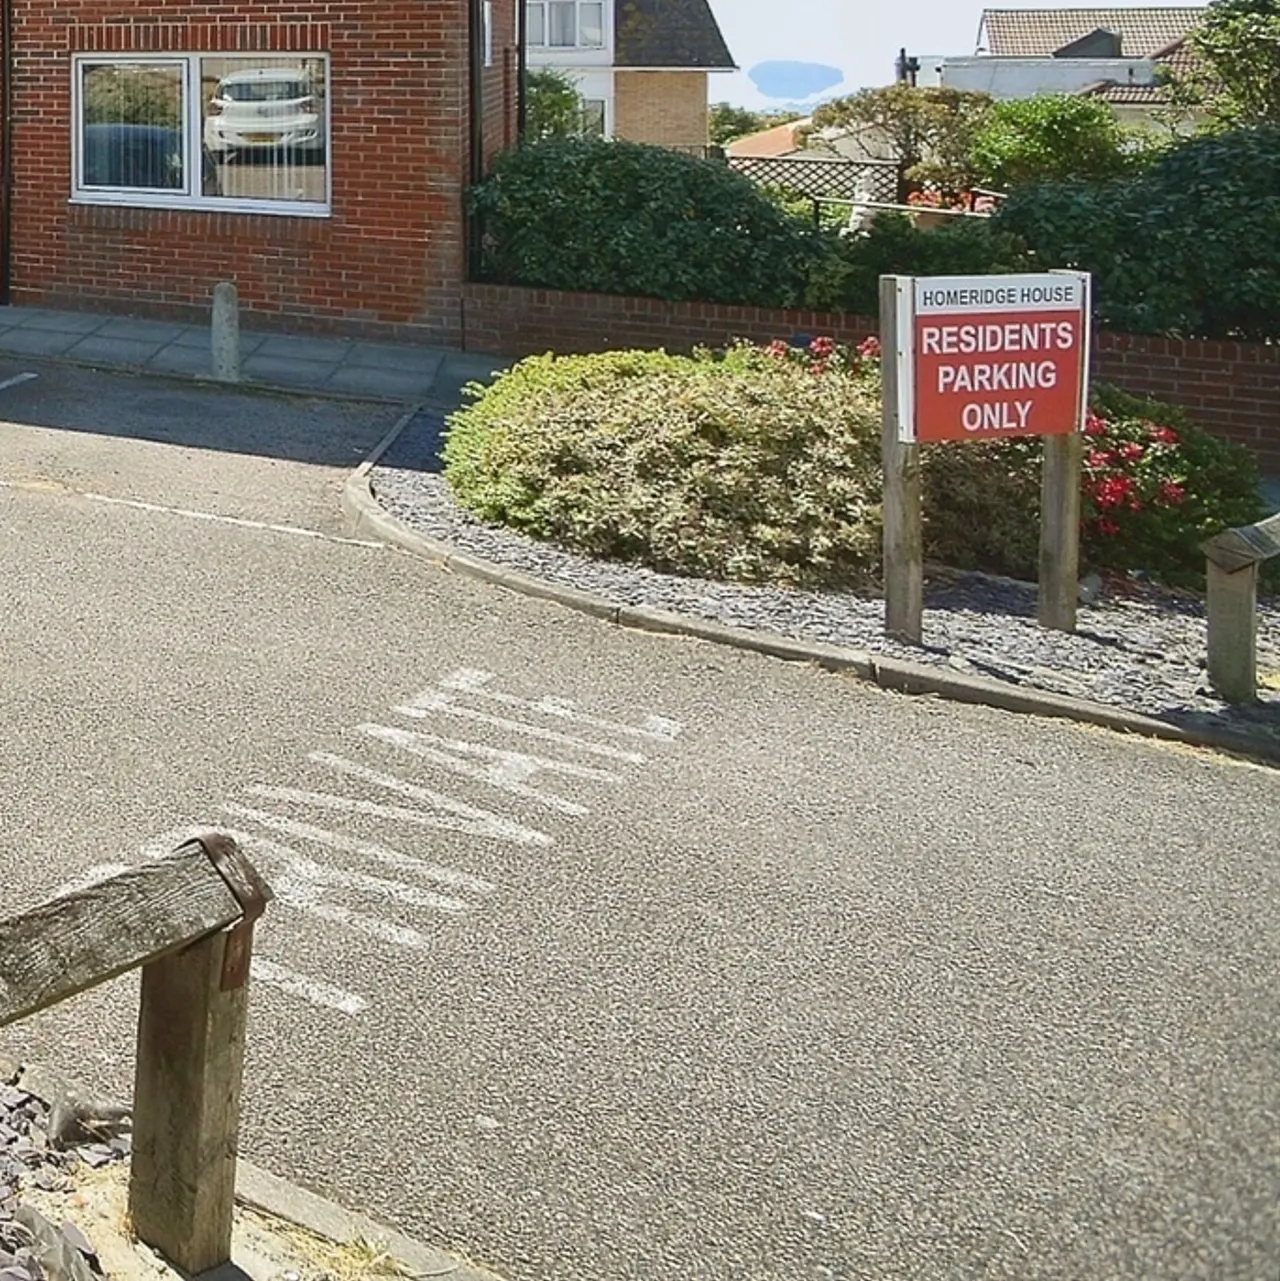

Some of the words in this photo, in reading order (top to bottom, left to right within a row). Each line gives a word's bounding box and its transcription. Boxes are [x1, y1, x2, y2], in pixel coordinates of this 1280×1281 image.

[923, 287, 1016, 307] HOMERIDGE
[1020, 285, 1074, 303] HOUSE
[921, 321, 1074, 355] RESIDENTS
[938, 360, 1057, 393] PARKING
[961, 400, 1033, 432] ONLY
